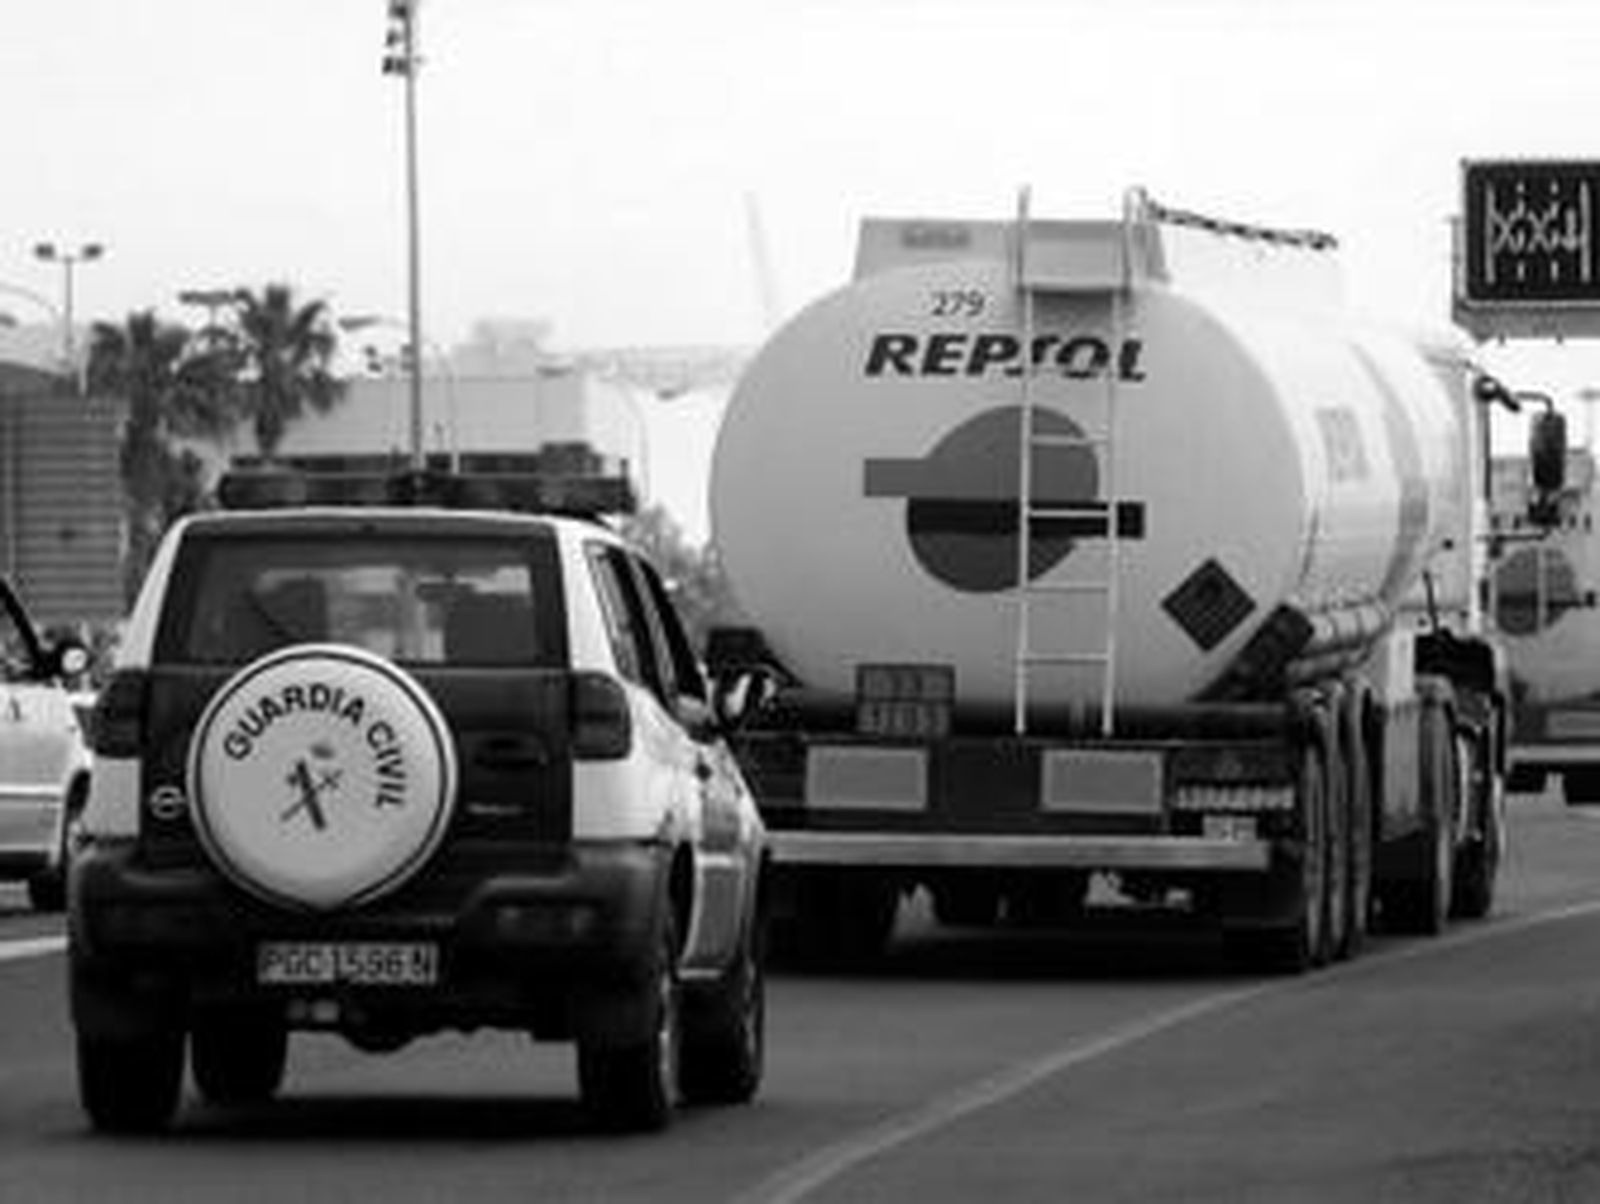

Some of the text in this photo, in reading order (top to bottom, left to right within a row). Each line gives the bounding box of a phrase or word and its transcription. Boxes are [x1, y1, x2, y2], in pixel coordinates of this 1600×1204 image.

[930, 289, 986, 316] 279
[223, 682, 407, 808] GUARDIA CIVIL
